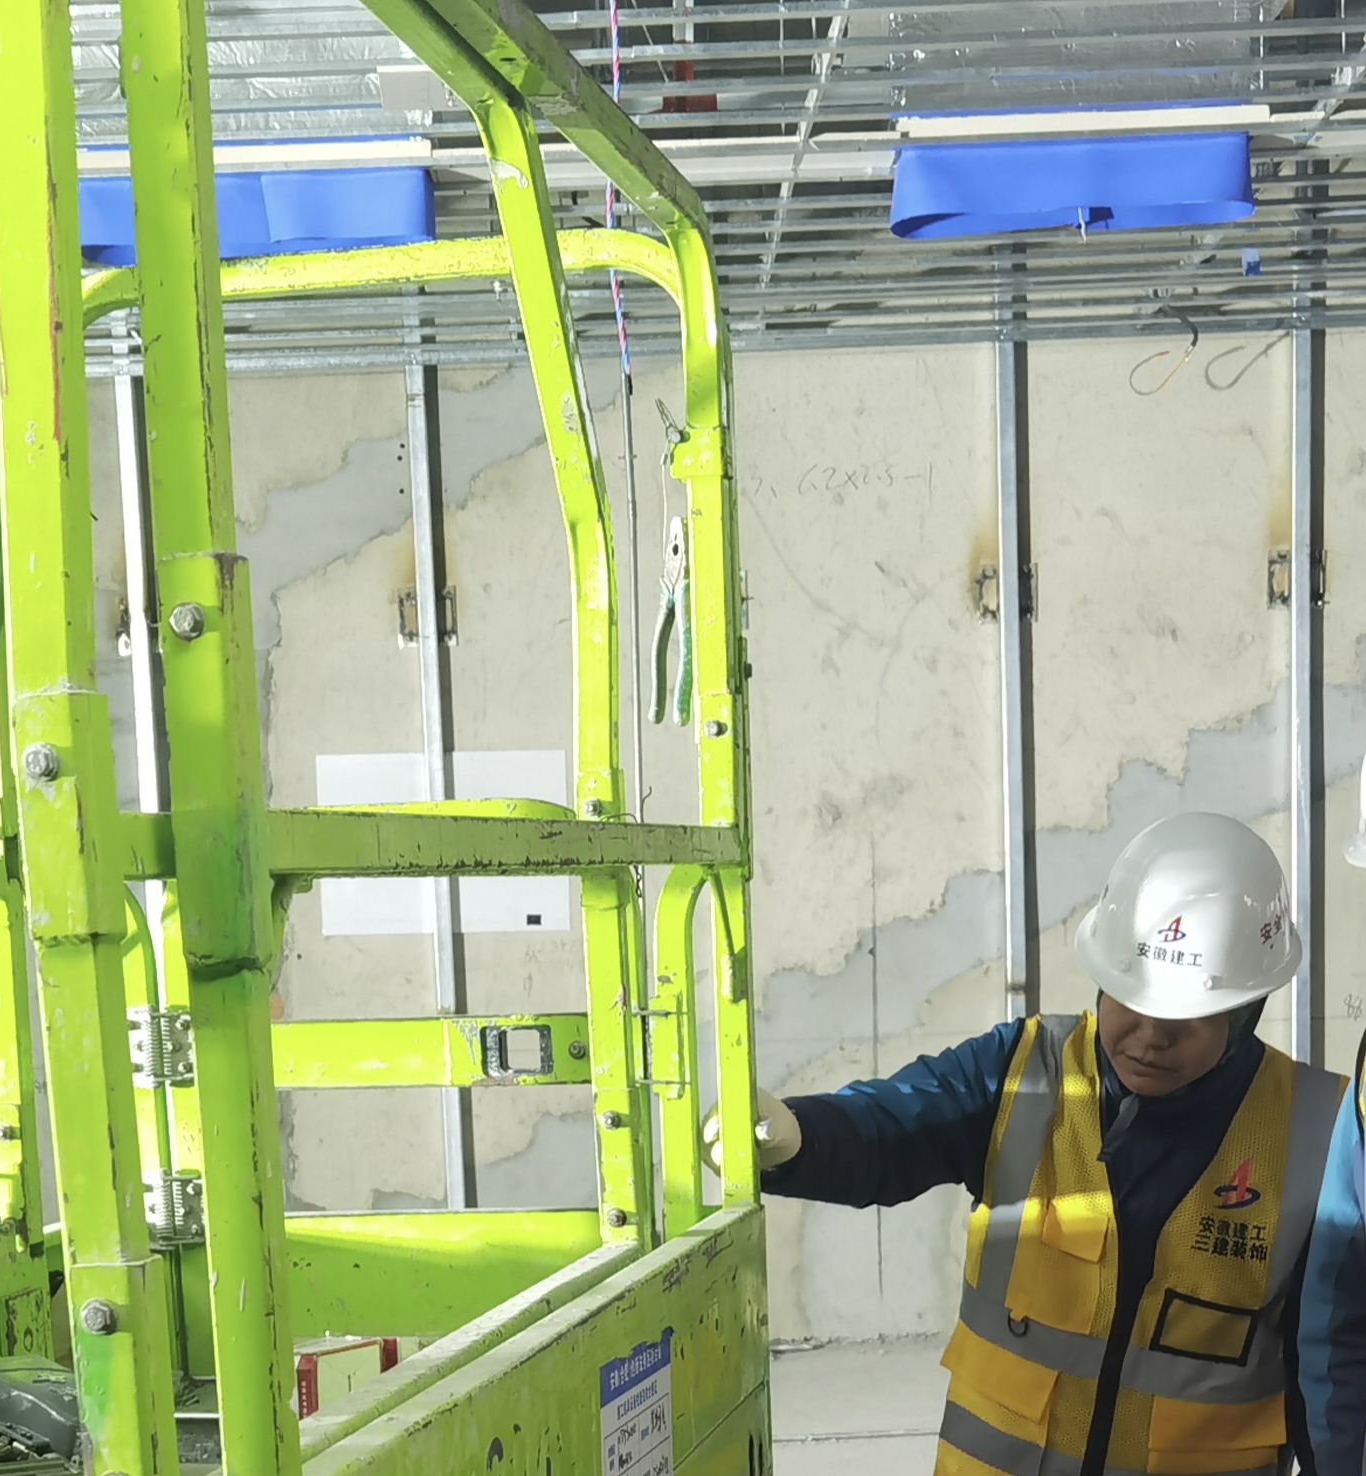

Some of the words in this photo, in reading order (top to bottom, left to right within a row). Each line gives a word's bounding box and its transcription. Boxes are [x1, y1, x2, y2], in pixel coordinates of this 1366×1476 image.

[1135, 942, 1204, 968] 安徽建工
[1198, 1215, 1268, 1242] 安徽建工
[1191, 1233, 1269, 1263] 三建装饰
